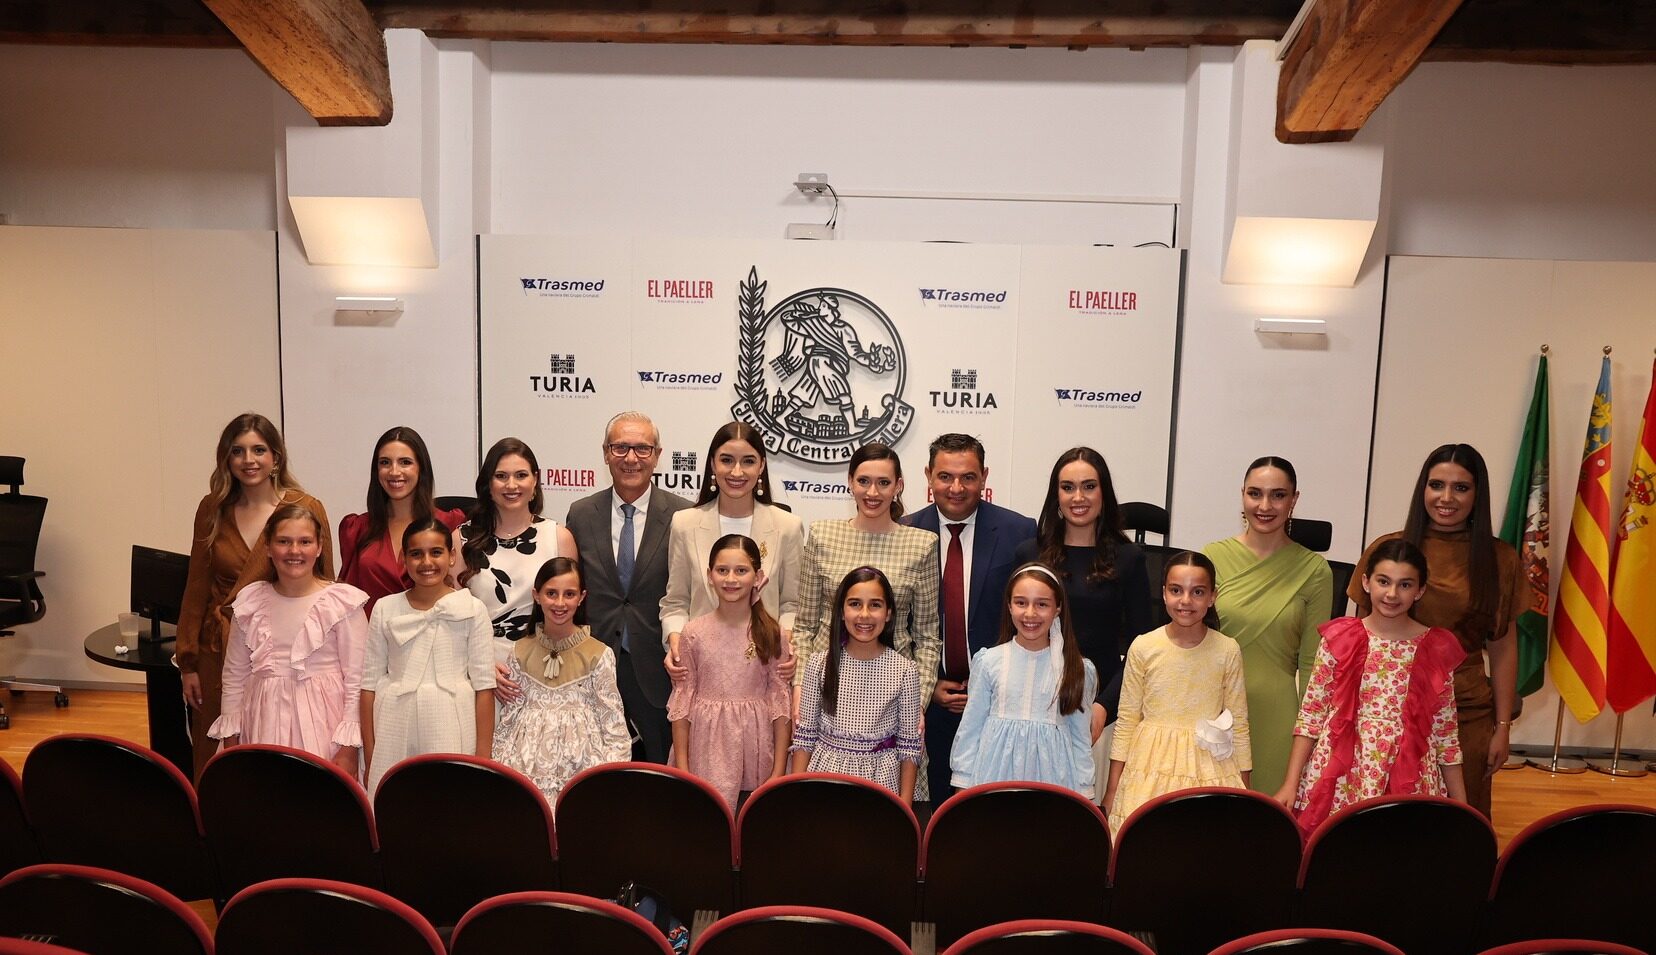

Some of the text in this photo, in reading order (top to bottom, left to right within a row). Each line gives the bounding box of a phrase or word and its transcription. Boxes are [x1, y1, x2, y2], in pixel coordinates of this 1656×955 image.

[537, 279, 604, 291] Trasmed
[648, 280, 713, 299] EL PAELLER
[937, 289, 1006, 302] Trasmed
[1069, 290, 1136, 310] EL PAELLER
[530, 376, 596, 393] TURIA
[654, 372, 722, 383] Trasmed
[929, 391, 998, 408] TURIA
[1072, 389, 1142, 402] Trasmed
[735, 403, 910, 460] Junta Central allera
[547, 469, 595, 487] PAELLER
[652, 473, 701, 490] TURI
[799, 481, 852, 494] Trasm
